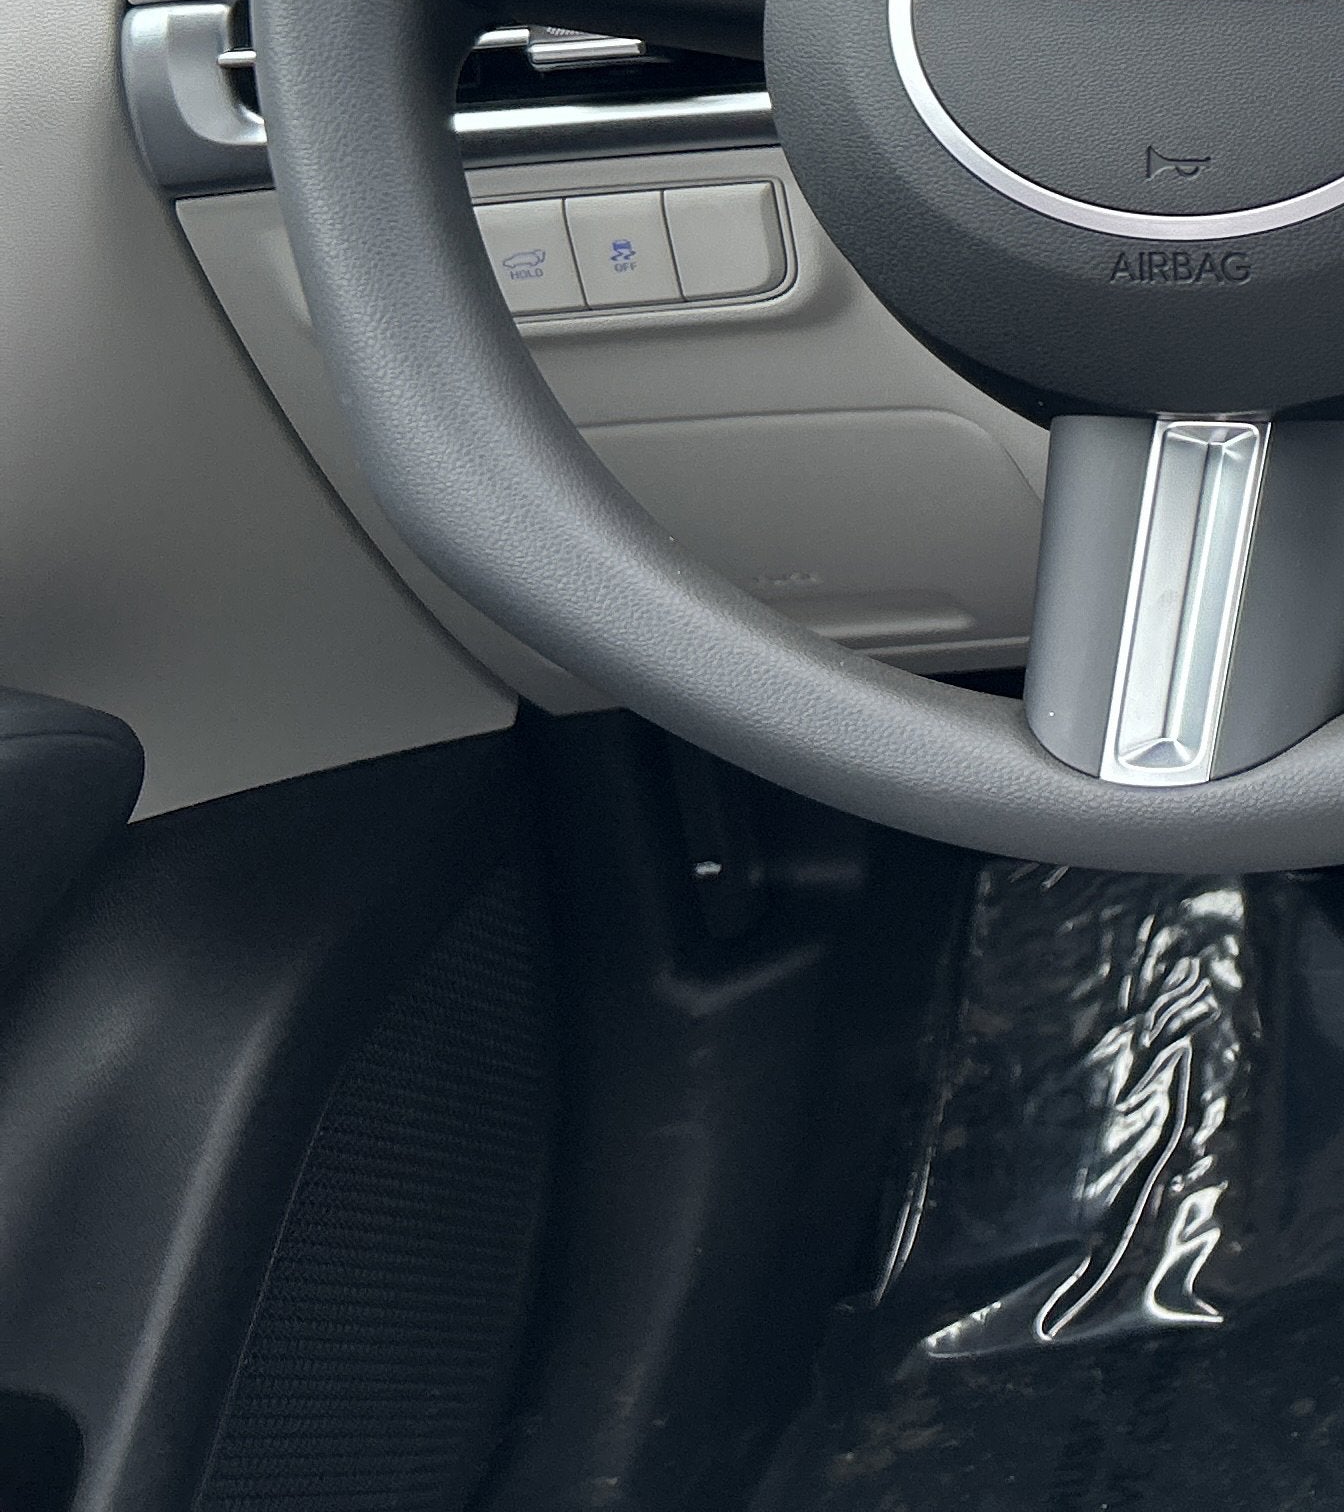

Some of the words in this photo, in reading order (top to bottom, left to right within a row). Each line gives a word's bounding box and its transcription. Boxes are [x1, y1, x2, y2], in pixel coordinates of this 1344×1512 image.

[613, 262, 638, 273] OFF
[1110, 251, 1251, 285] AIRBAG
[510, 268, 544, 280] HOLD
